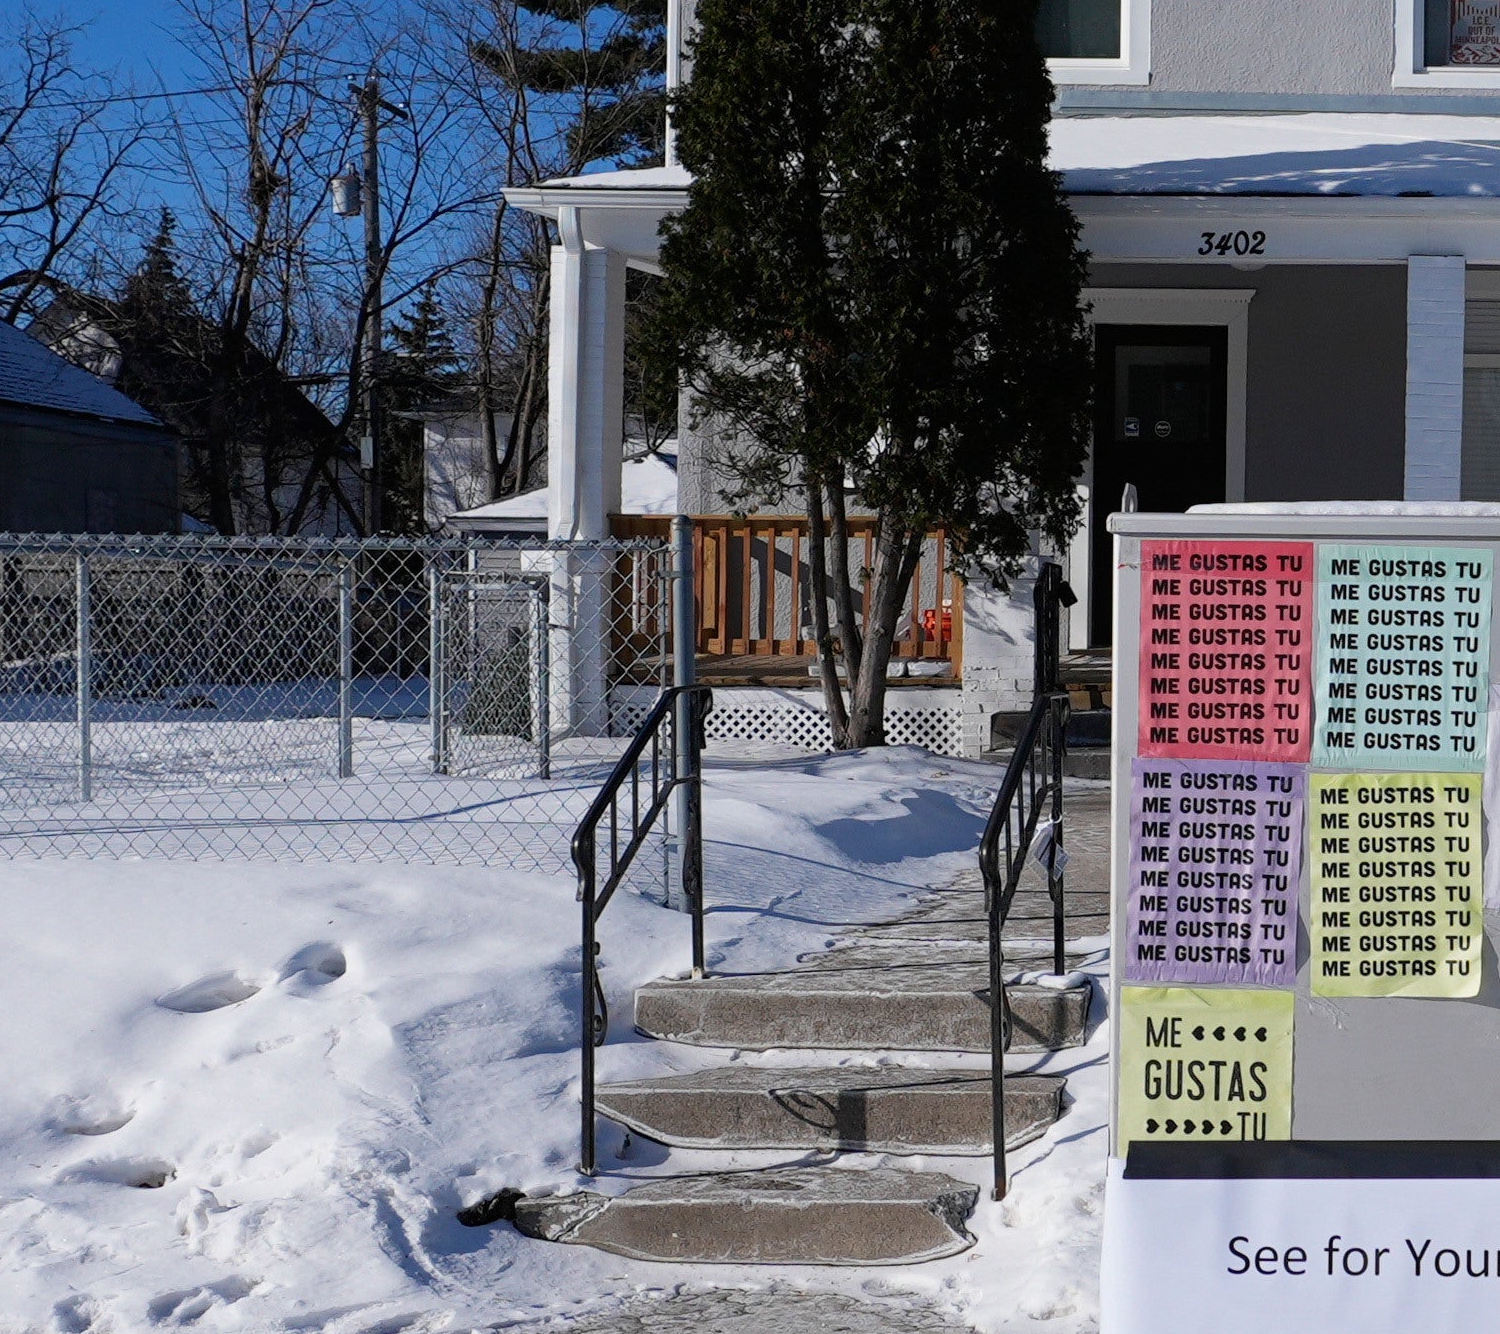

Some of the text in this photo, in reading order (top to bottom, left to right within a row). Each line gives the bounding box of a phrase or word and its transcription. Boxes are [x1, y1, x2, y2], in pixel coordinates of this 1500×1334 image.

[1469, 26, 1496, 35] OUT OF
[1197, 230, 1266, 256] 3402
[1152, 553, 1303, 572] ME GUSTAS TU
[1331, 558, 1482, 580] ME GUSTAS TU
[1152, 578, 1302, 597] ME GUSTAS TU
[1331, 584, 1481, 604] ME GUSTAS TU
[1152, 603, 1301, 622] ME GUSTAS TU
[1330, 608, 1480, 629] ME GUSTAS TU
[1151, 627, 1301, 647] ME GUSTAS TU
[1330, 633, 1479, 654] ME GUSTAS TU
[1151, 652, 1301, 671] ME GUSTAS TU
[1329, 657, 1478, 679] ME GUSTAS TU
[1150, 677, 1300, 696] ME GUSTAS TU
[1328, 682, 1477, 703] ME GUSTAS TU
[1150, 702, 1299, 720] ME GUSTAS TU
[1327, 706, 1477, 728] ME GUSTAS TU
[1150, 726, 1299, 745] ME GUSTAS TU
[1326, 731, 1476, 753] ME GUSTAS TU
[1143, 772, 1293, 794] ME GUSTAS TU
[1320, 786, 1470, 805] ME GUSTAS TU
[1142, 796, 1292, 818] ME GUSTAS TU
[1320, 811, 1469, 830] ME GUSTAS TU
[1141, 821, 1290, 842] ME GUSTAS TU
[1321, 836, 1470, 854] ME GUSTAS TU
[1141, 845, 1289, 867] ME GUSTAS TU
[1321, 860, 1470, 879] ME GUSTAS TU
[1140, 870, 1288, 892] ME GUSTAS TU
[1322, 885, 1471, 903] ME GUSTAS TU
[1139, 895, 1287, 917] ME GUSTAS TU
[1322, 910, 1471, 928] ME GUSTAS TU
[1138, 919, 1286, 941] ME GUSTAS TU
[1322, 934, 1471, 953] ME GUSTAS TU
[1137, 944, 1285, 965] ME GUSTAS TU
[1322, 959, 1470, 977] ME GUSTAS TU
[1145, 1016, 1183, 1048] ME
[1144, 1059, 1268, 1102] GUSTAS
[1236, 1111, 1267, 1141] TU
[1227, 1236, 1307, 1276] See
[1324, 1235, 1390, 1276] for
